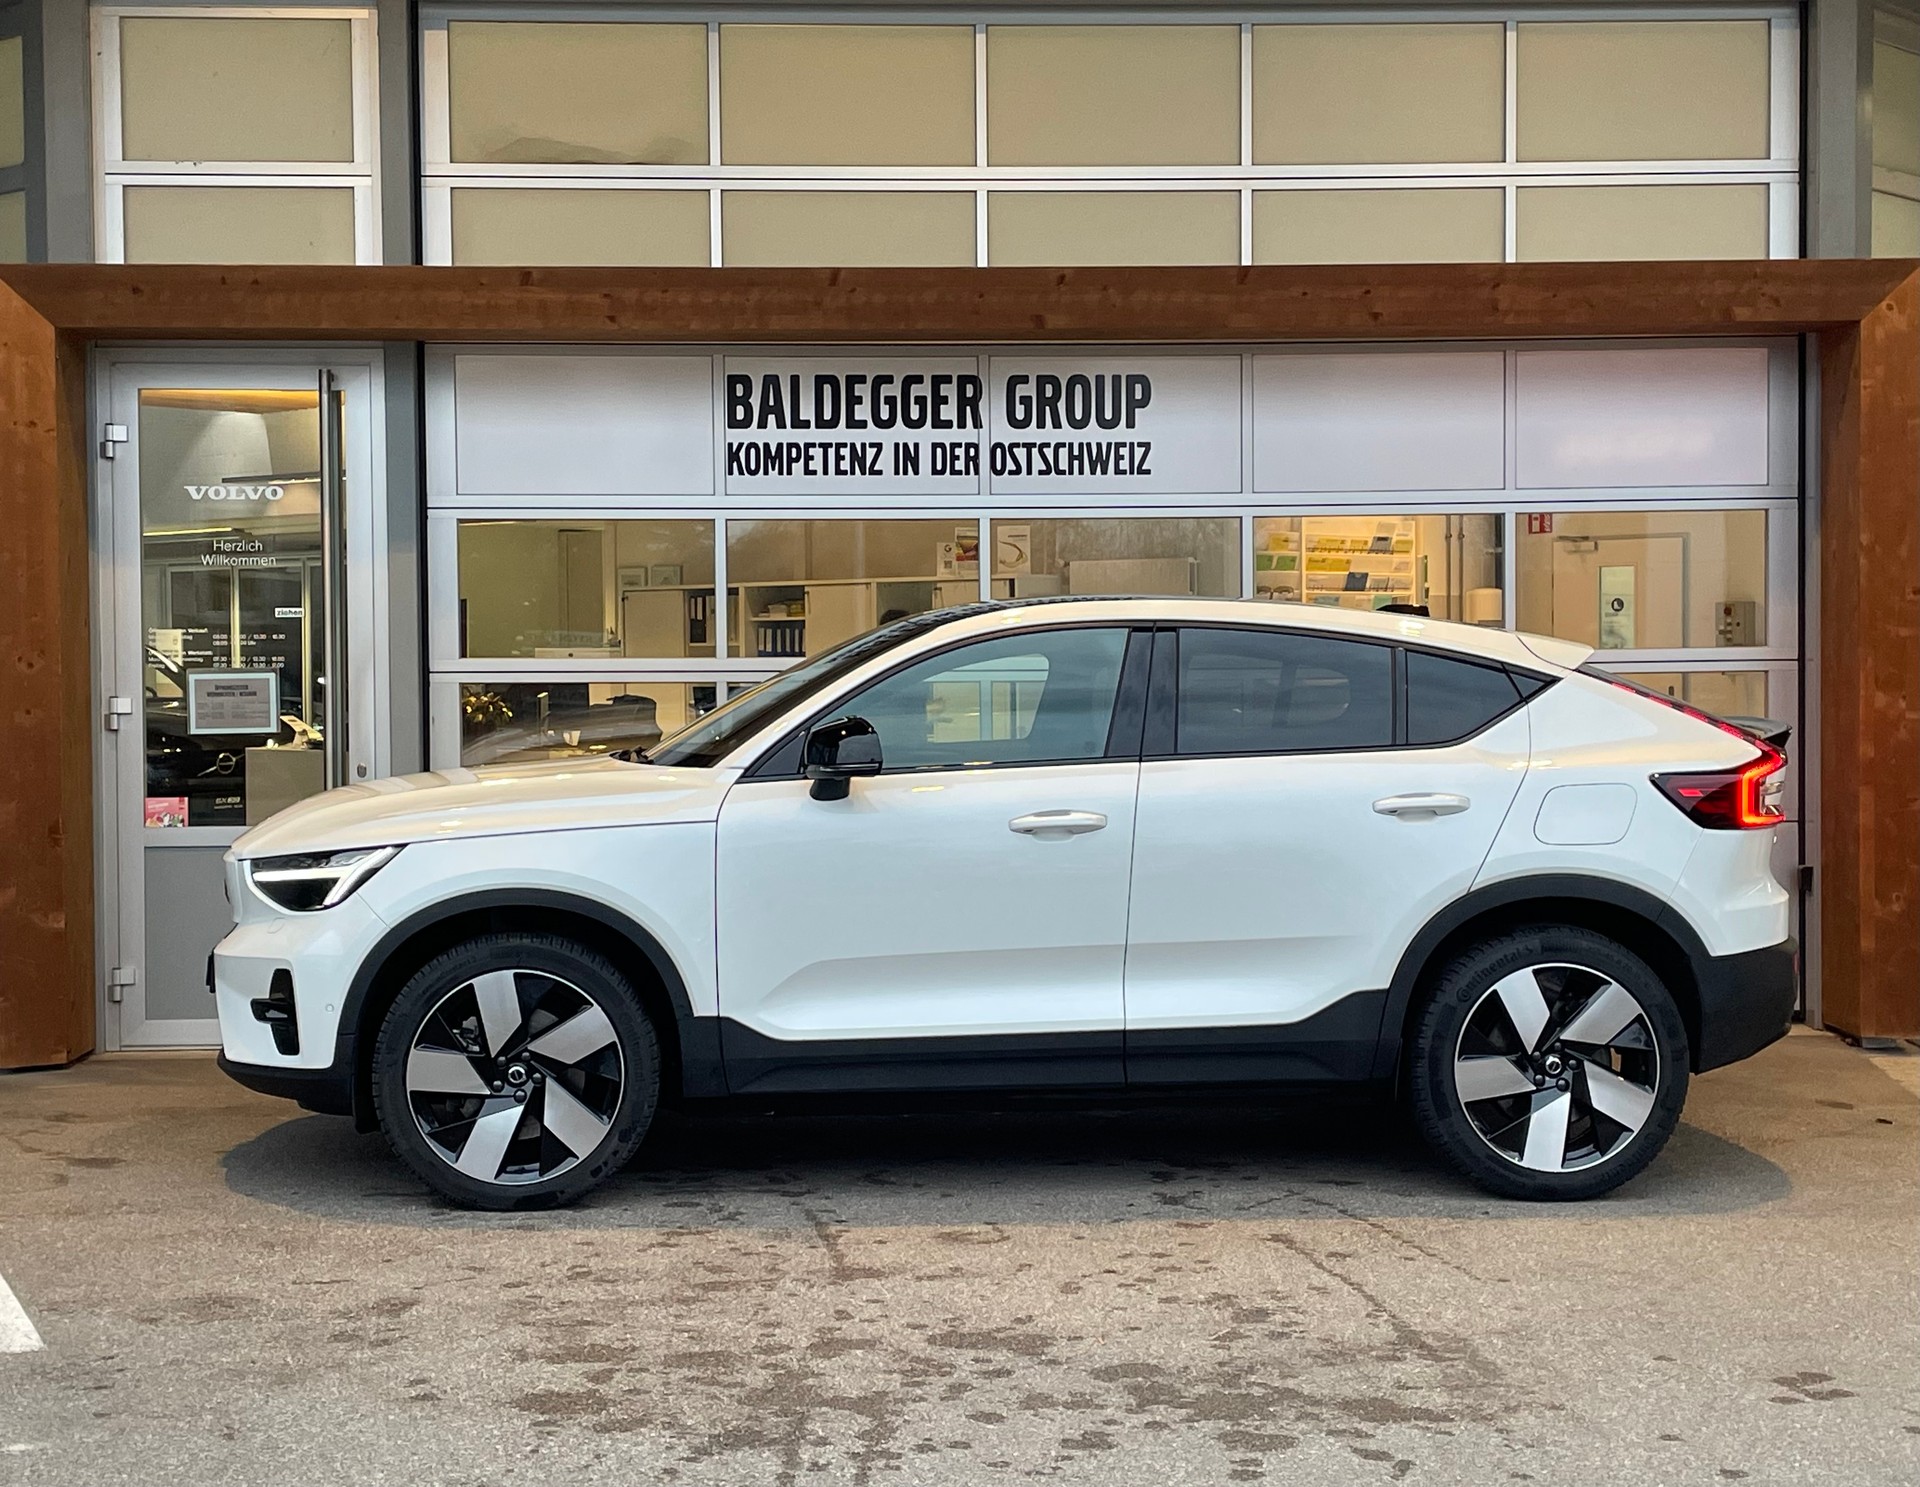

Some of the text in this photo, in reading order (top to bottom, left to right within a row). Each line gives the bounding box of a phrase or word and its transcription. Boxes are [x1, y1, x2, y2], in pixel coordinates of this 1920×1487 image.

[726, 374, 1152, 430] BALDEGGER GROUP
[726, 441, 1152, 476] KOMPETENZ IN DER OSTSCHWEIZ
[184, 485, 284, 500] VOLVO
[213, 540, 263, 552] Herzlich
[201, 554, 277, 567] Willkommen
[1456, 948, 1521, 1003] Continental
